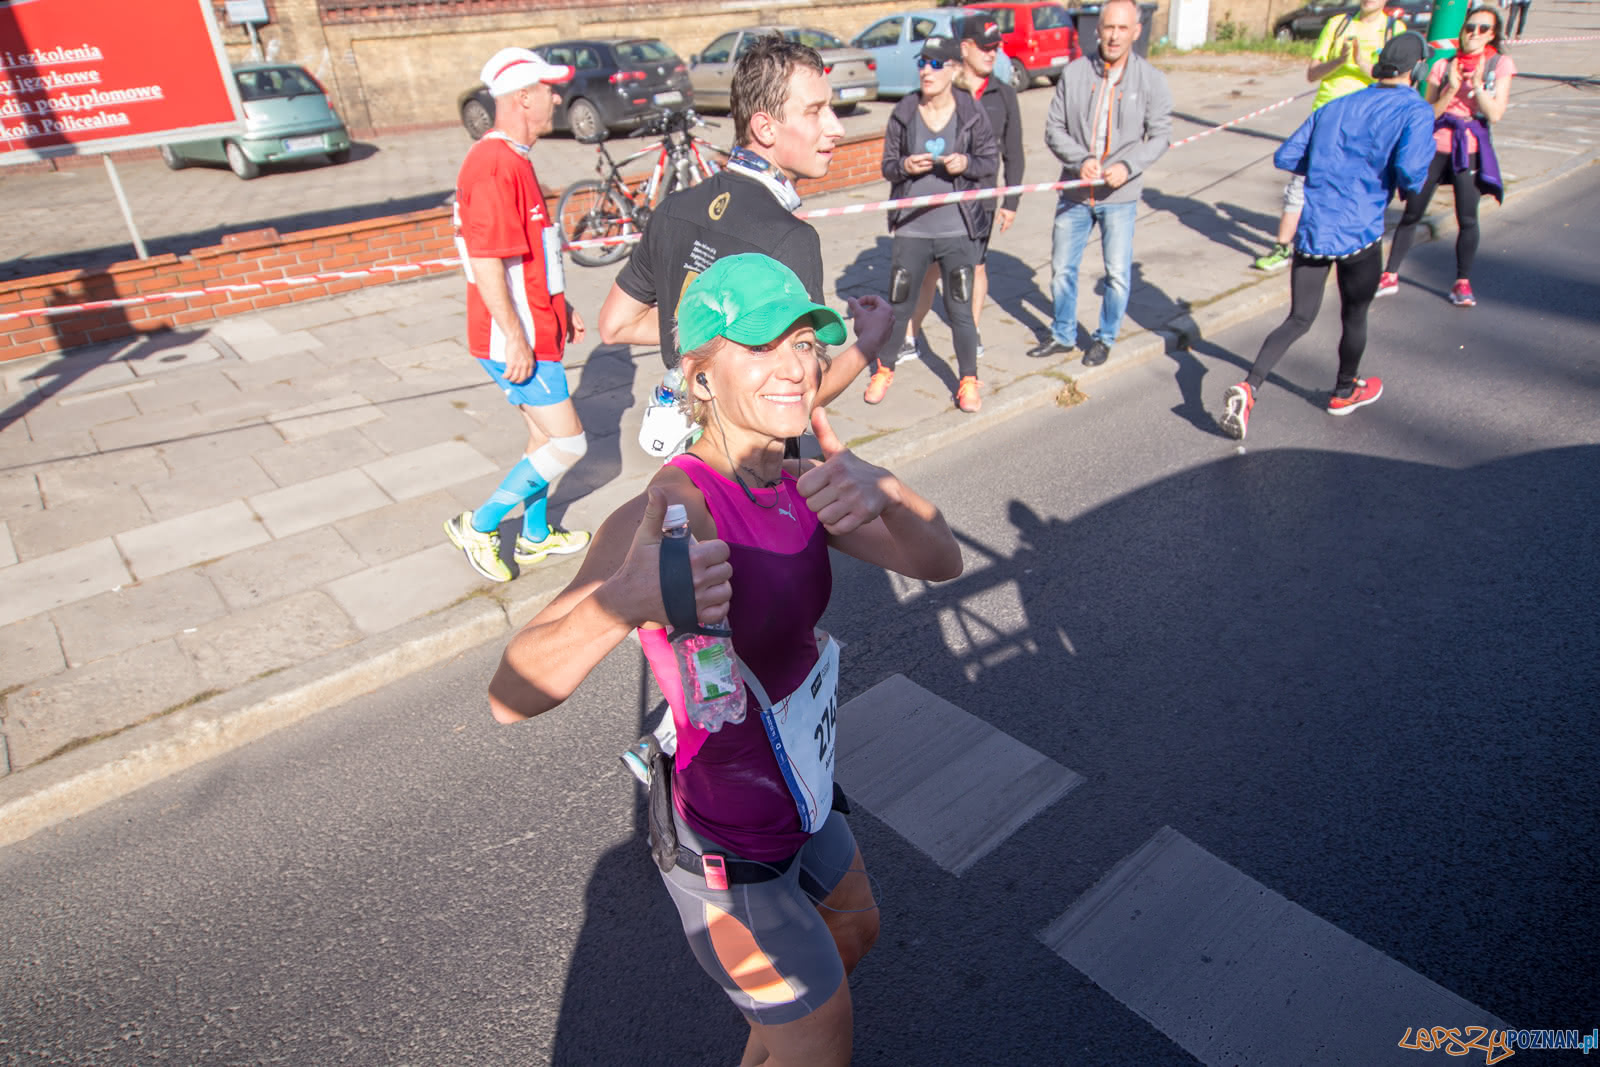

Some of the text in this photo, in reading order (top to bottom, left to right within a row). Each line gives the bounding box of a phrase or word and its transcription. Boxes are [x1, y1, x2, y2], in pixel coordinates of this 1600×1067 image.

[5, 51, 16, 66] i
[18, 44, 102, 66] szkolenia
[16, 70, 99, 94] językowe
[0, 85, 162, 115] dia podyplomowe
[41, 111, 128, 134] Policealna
[814, 684, 837, 762] 274
